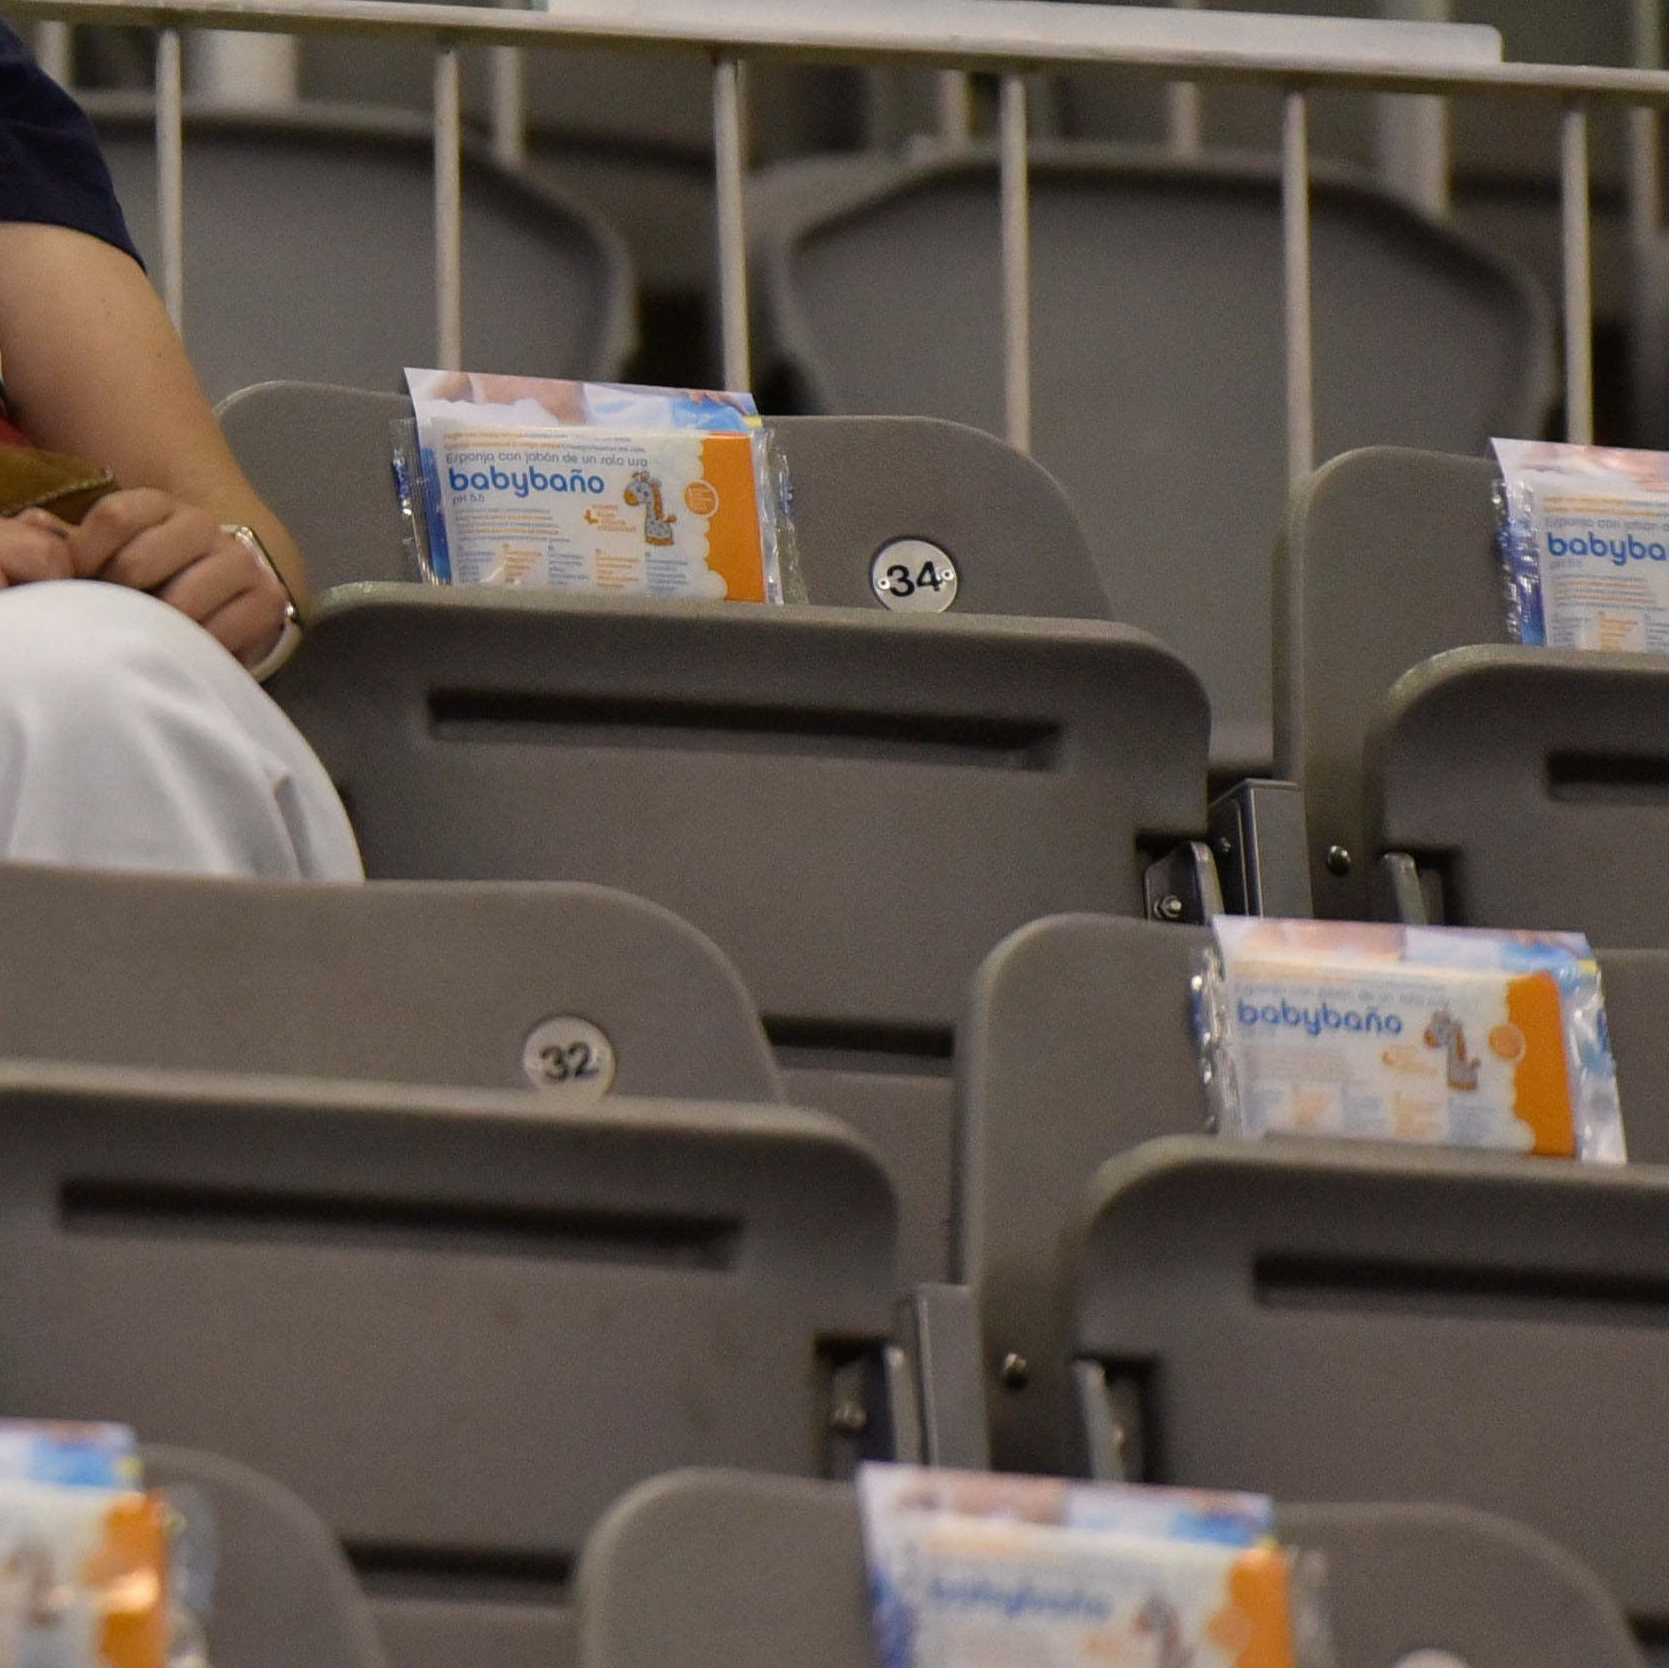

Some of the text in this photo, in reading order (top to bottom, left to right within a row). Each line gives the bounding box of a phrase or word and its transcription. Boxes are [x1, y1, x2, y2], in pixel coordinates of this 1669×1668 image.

[498, 452, 522, 461] con
[563, 451, 578, 463] de
[582, 454, 597, 464] un
[448, 465, 605, 498] babybaño
[1547, 531, 1669, 567] babyba
[887, 561, 942, 597] 34
[1237, 997, 1403, 1037] babybaño
[540, 1041, 600, 1082] 32
